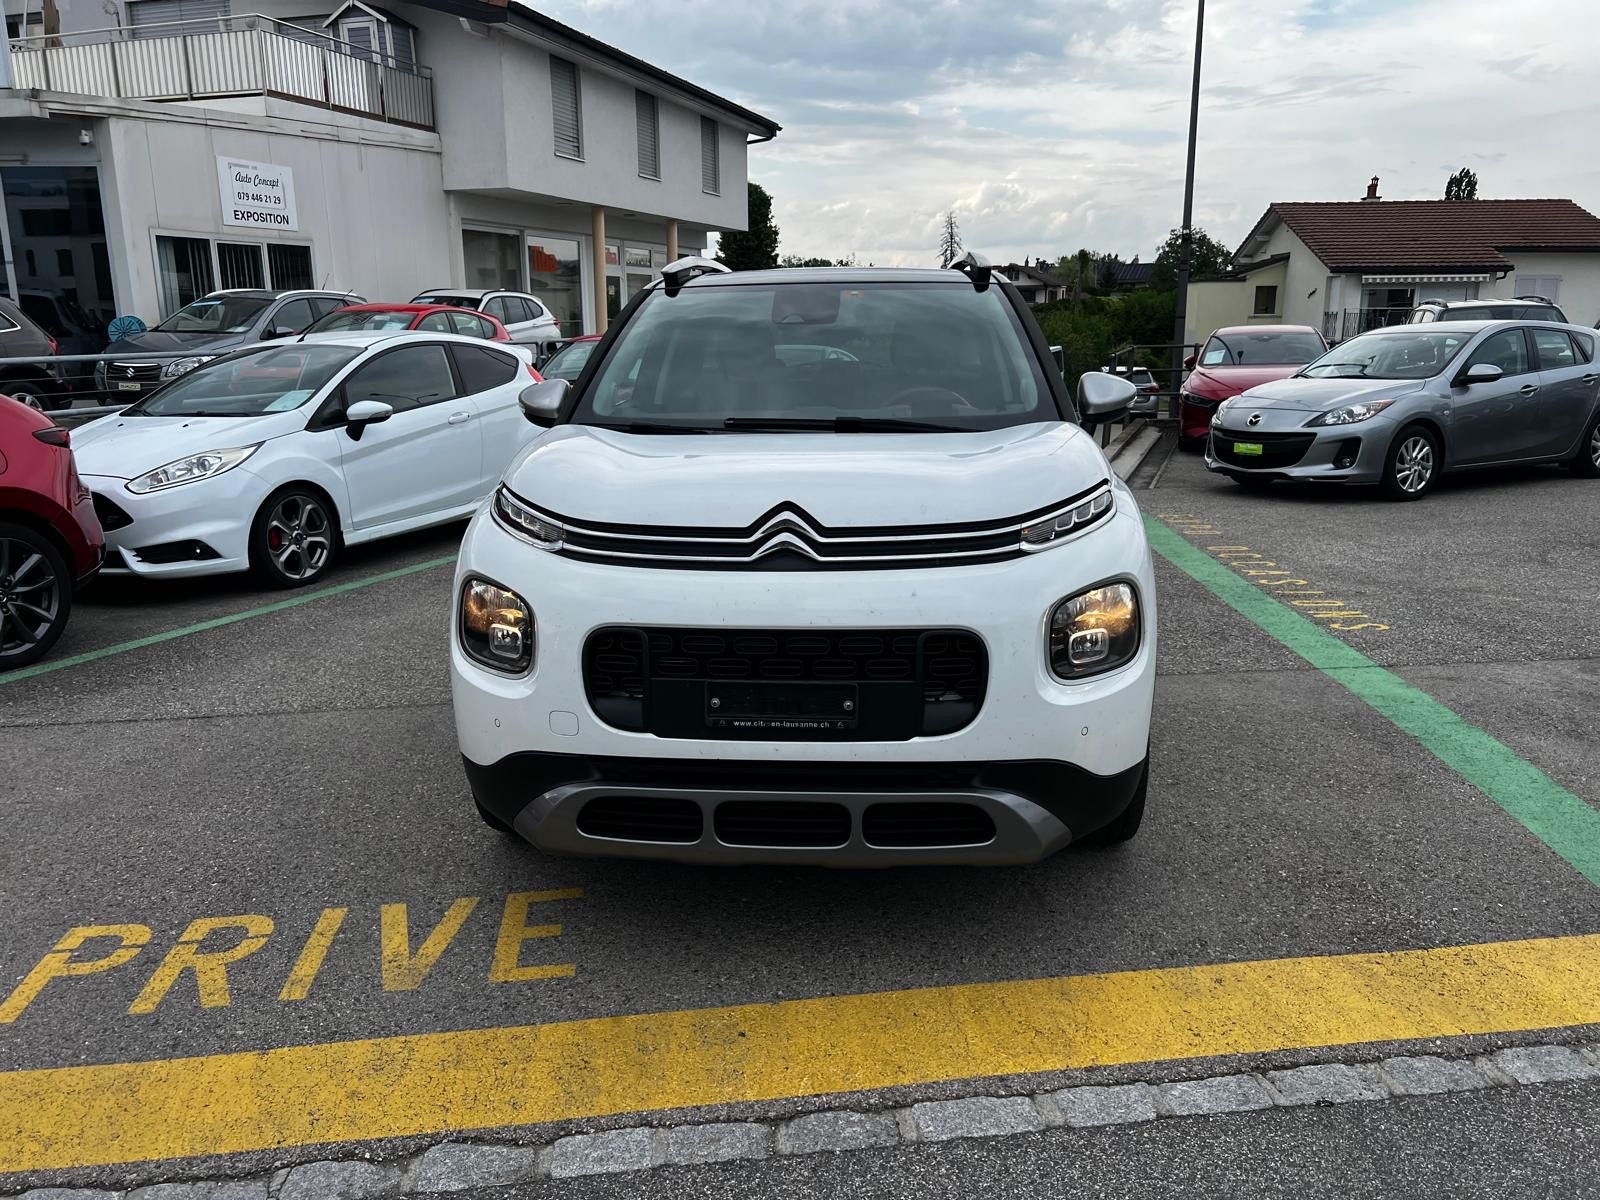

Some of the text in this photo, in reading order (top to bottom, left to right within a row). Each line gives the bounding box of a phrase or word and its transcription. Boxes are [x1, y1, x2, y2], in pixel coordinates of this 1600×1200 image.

[235, 171, 279, 189] Auto Concept
[237, 191, 281, 205] 079 446 21 29
[233, 209, 290, 225] EXPOSITION
[1207, 545, 1390, 631] OCCASIONS
[733, 720, 830, 729] www.citren-lausanne.ch
[0, 886, 585, 1024] PRIVE
